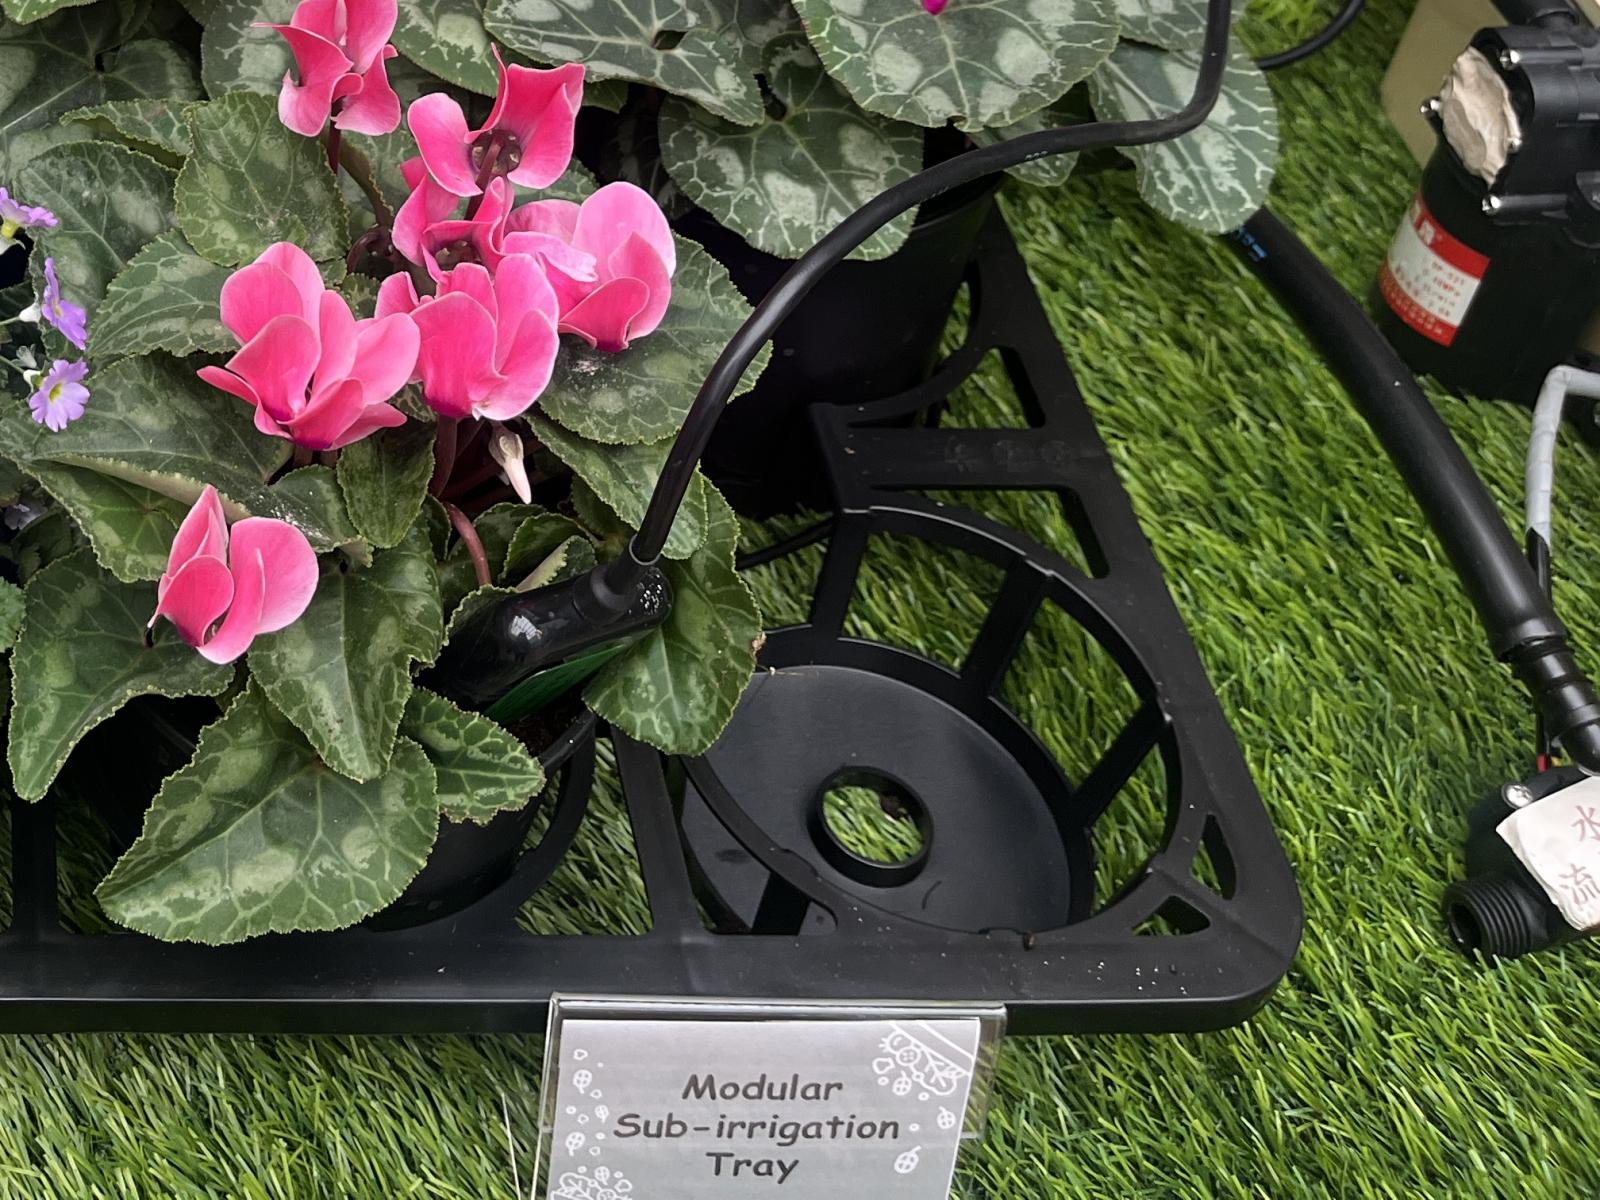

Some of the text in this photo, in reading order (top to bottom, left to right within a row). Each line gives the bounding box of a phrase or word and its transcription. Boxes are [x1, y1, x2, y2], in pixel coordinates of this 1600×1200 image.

[681, 1073, 844, 1101] Modular
[612, 1112, 900, 1147] Sub-irrigation
[705, 1151, 800, 1185] Tray
